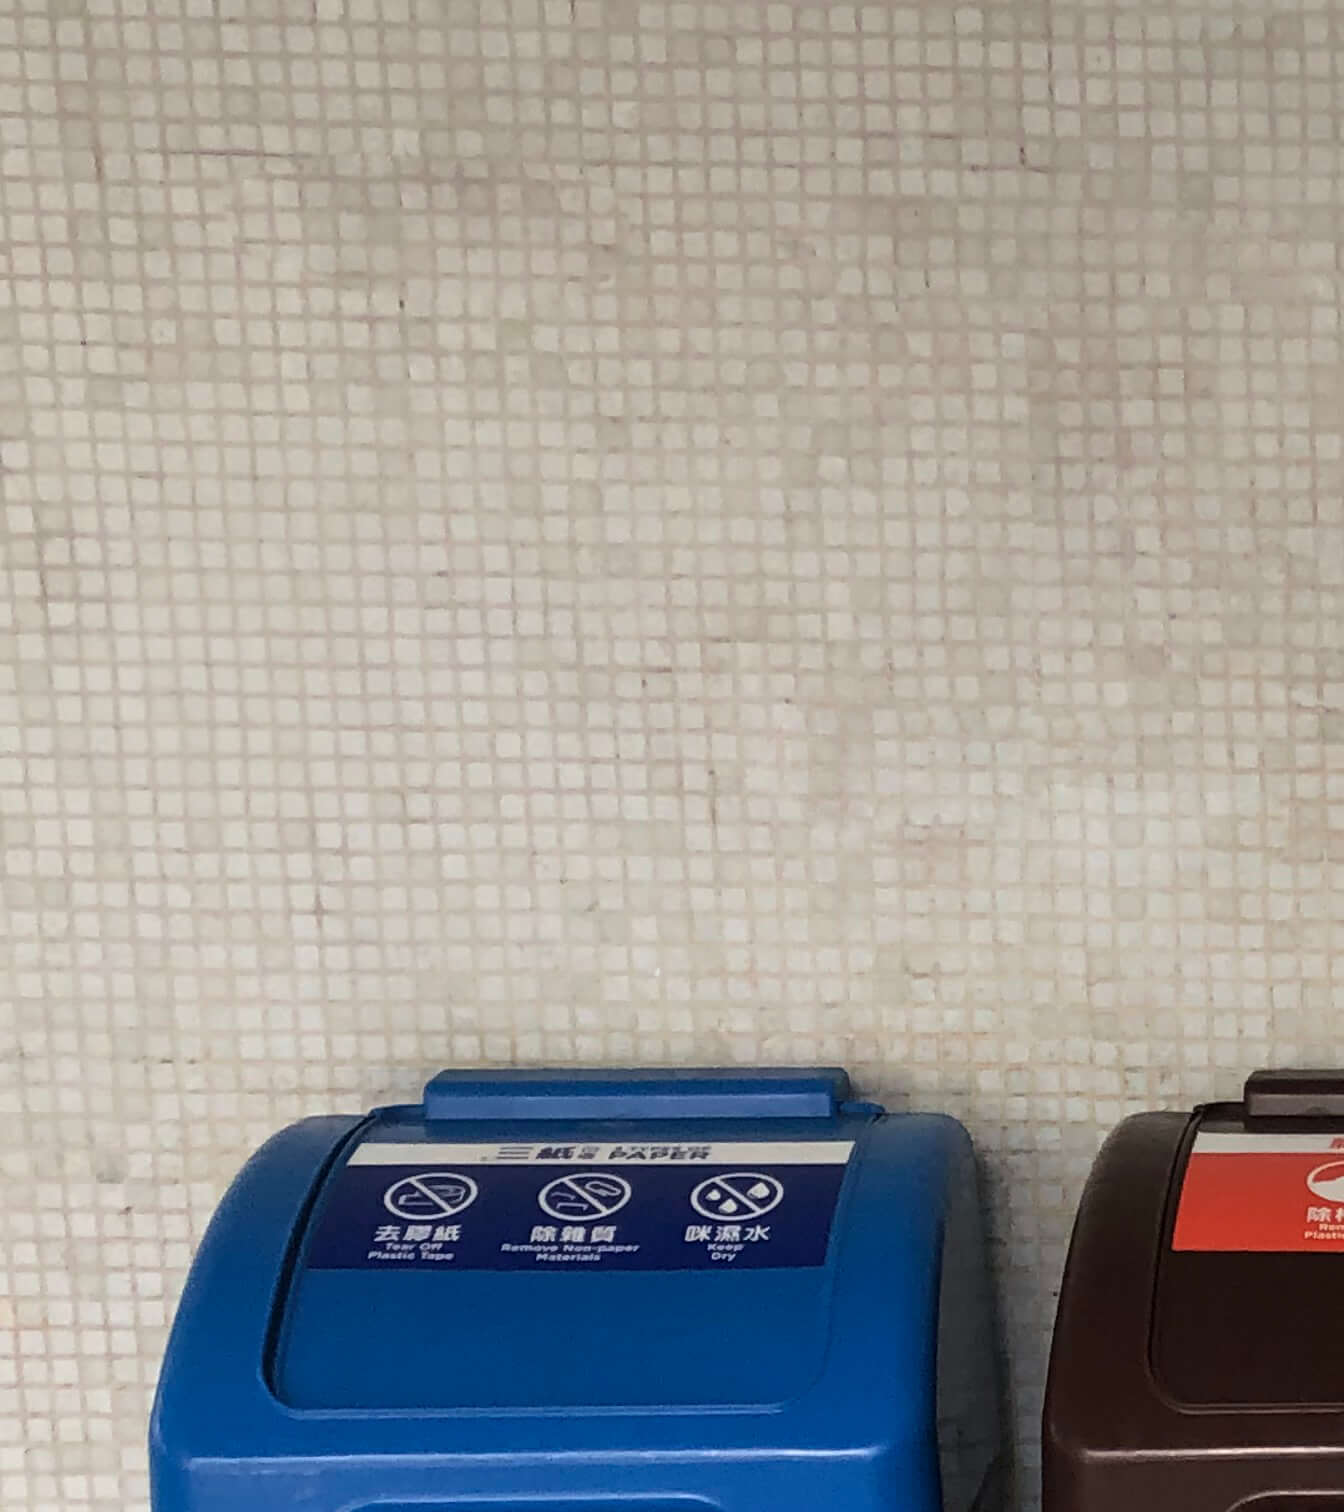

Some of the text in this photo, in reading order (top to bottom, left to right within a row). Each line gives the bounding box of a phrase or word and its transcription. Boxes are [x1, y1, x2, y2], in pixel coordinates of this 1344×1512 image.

[707, 1244, 744, 1252] Keep
[368, 1251, 416, 1260] Plastic
[536, 1253, 601, 1261] Materials
[711, 1252, 736, 1261] Dry
